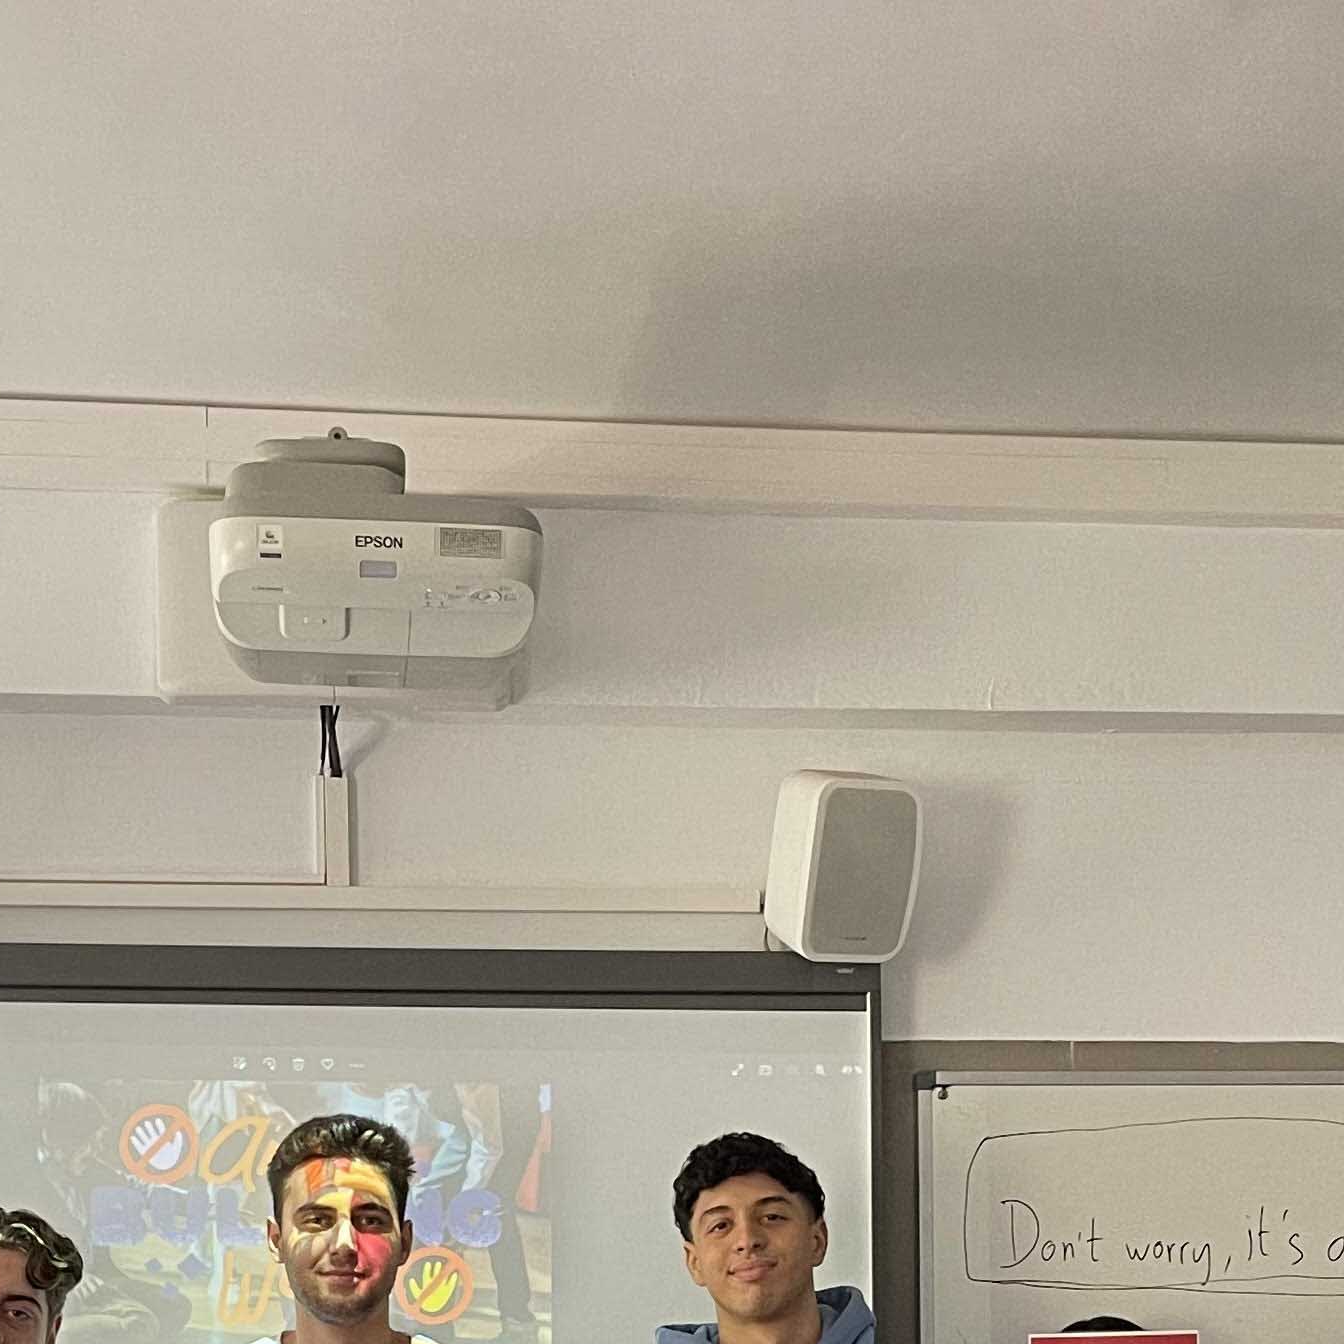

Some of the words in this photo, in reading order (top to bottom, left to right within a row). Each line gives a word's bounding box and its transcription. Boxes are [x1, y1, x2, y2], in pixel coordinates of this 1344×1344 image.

[355, 536, 403, 549] EPSON
[1001, 1199, 1102, 1271] Don't
[1246, 1205, 1305, 1264] it's
